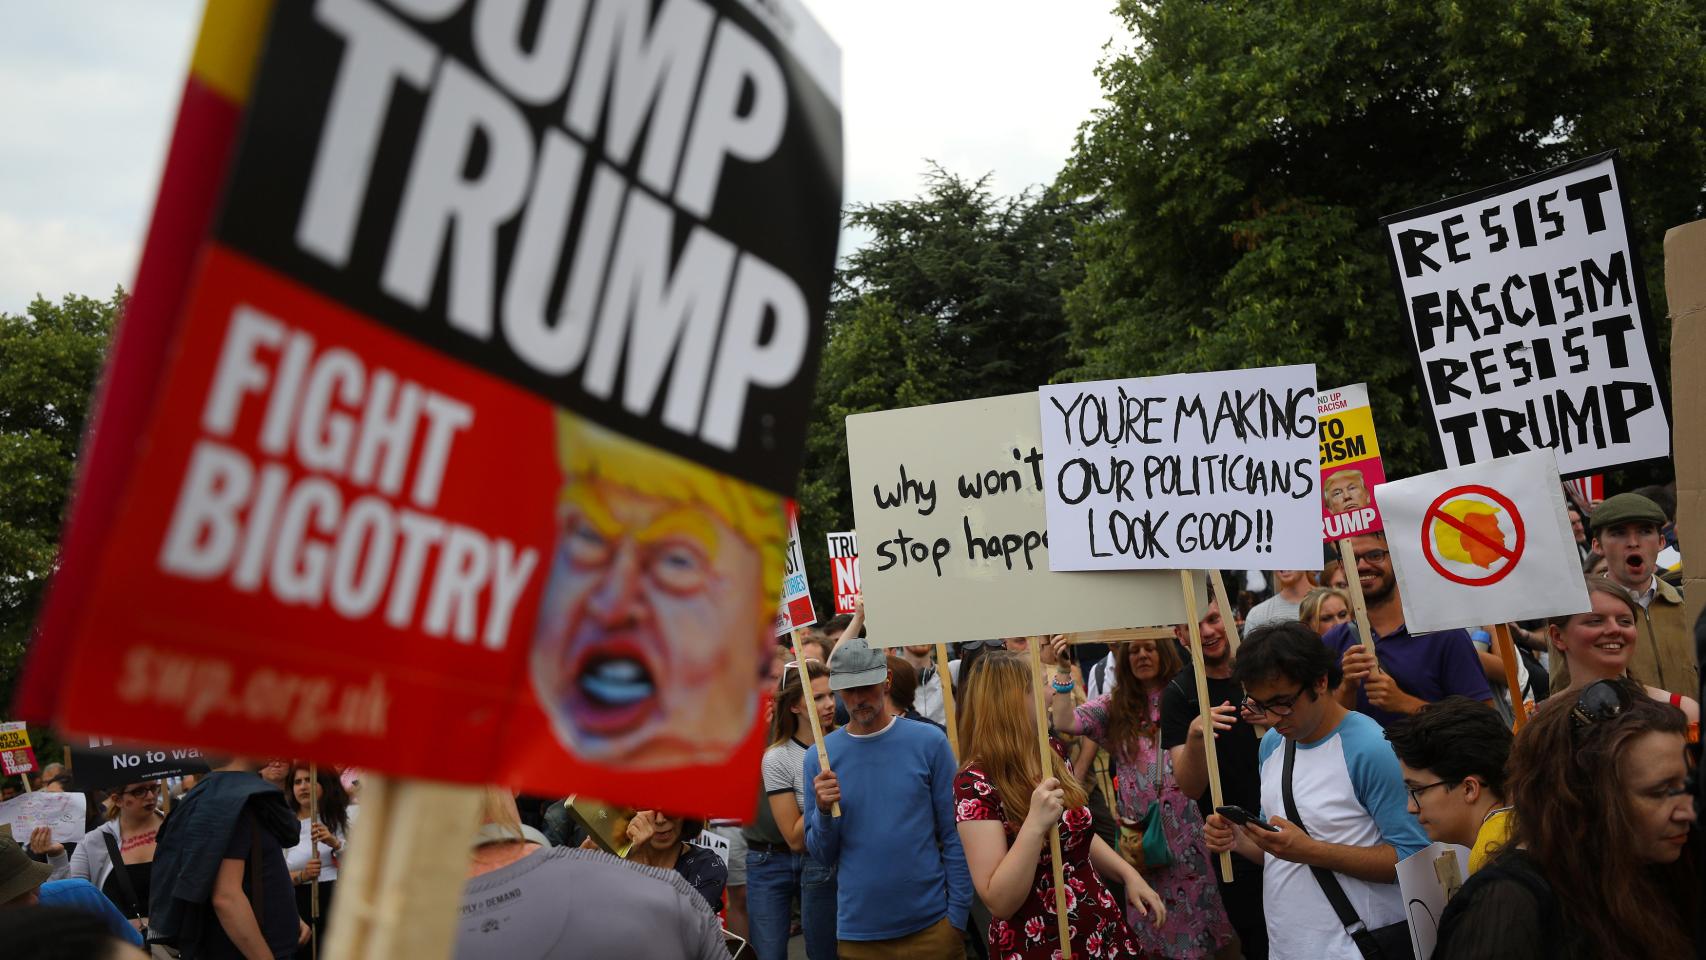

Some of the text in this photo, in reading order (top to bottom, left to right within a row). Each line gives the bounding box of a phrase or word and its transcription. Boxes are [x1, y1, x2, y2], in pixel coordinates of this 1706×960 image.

[376, 0, 789, 221] UMP
[294, 0, 810, 453] TRUMP
[1397, 174, 1613, 278] RESIST
[1411, 250, 1633, 353] FASCISM
[1330, 392, 1341, 401] UP
[1426, 314, 1636, 406] RESIST
[202, 303, 475, 509] FIGHT
[1174, 387, 1317, 445] MAKING
[1440, 381, 1655, 467] TRUMP
[873, 446, 1044, 516] why won't
[1057, 453, 1314, 505] OUR POLITICIANS
[160, 438, 540, 650] BIGOTRY
[876, 528, 951, 577] stop
[1088, 508, 1274, 559] LOOK GOOD!!
[118, 646, 388, 742] swp.org.uk
[112, 747, 203, 770] No to wa
[486, 888, 521, 907] DEMAND
